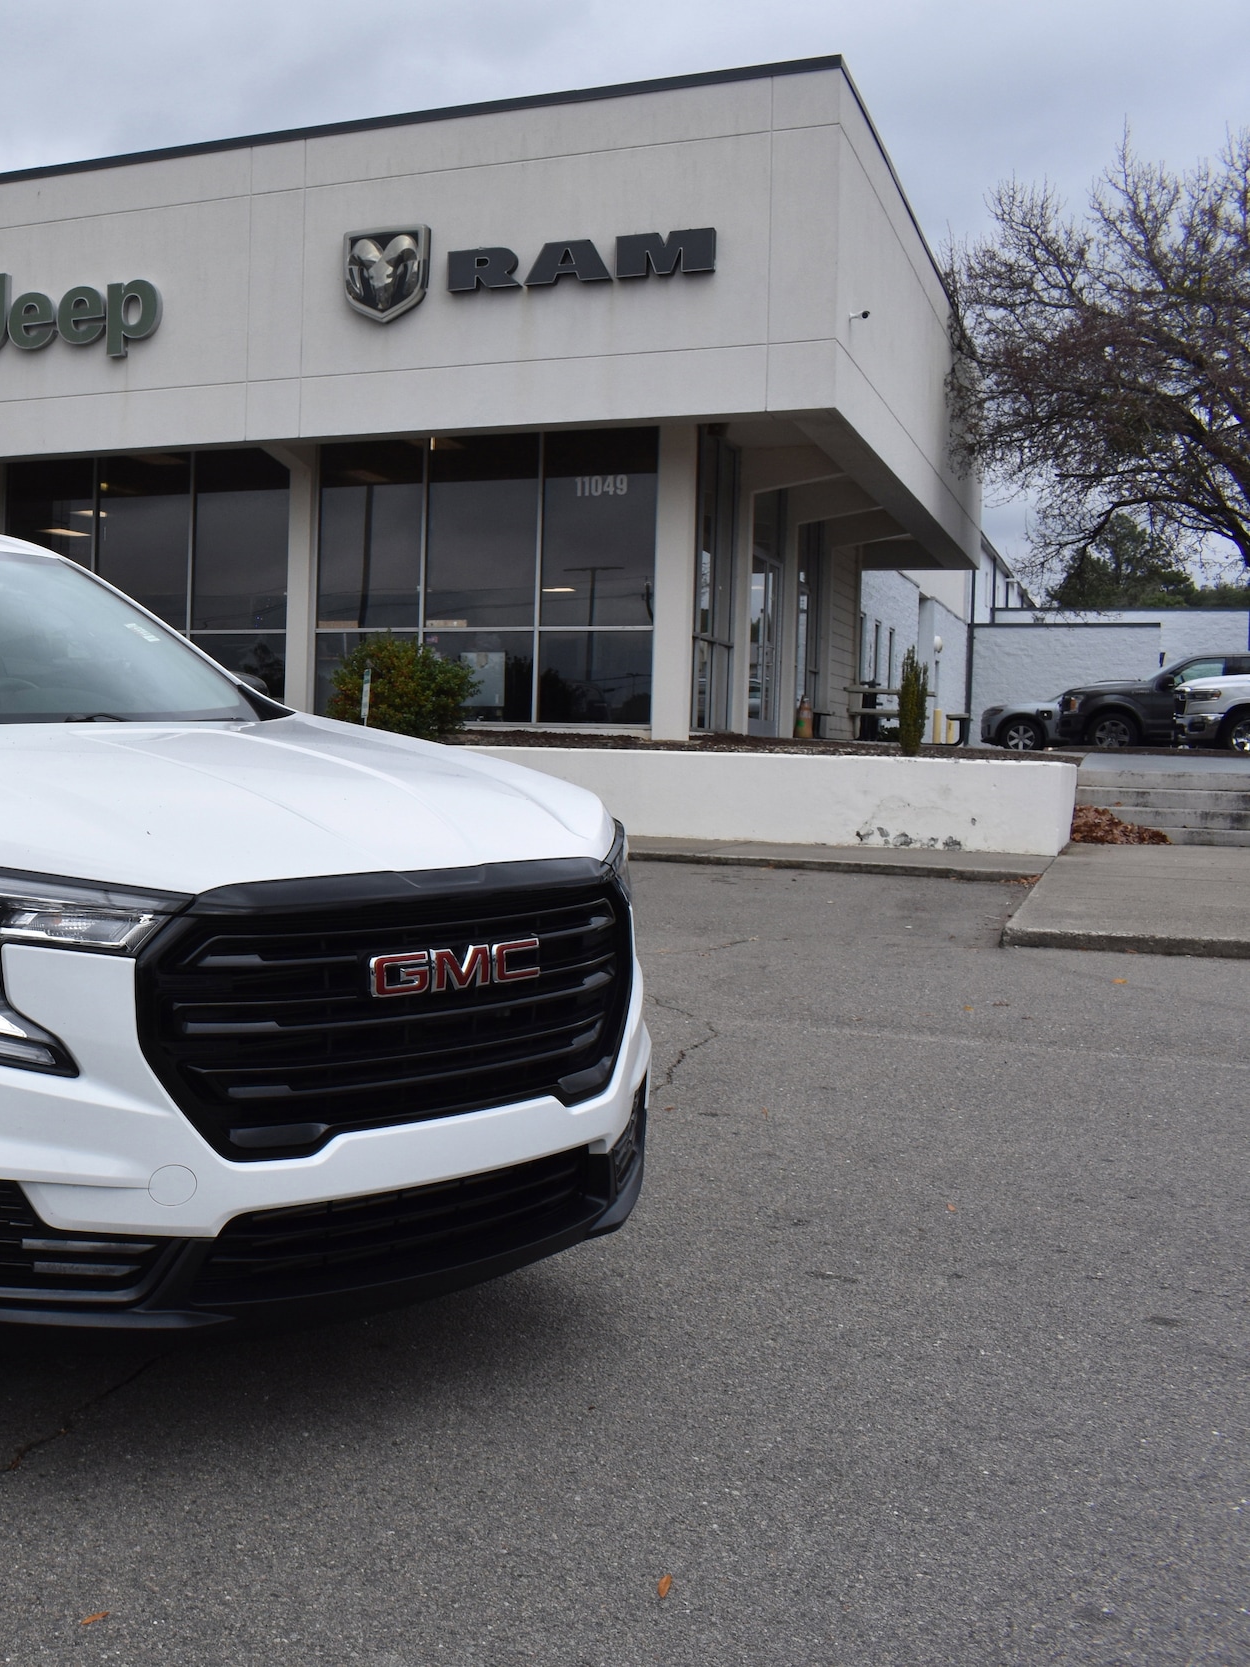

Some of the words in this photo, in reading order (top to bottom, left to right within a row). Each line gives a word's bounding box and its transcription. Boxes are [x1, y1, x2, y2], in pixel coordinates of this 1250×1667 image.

[447, 227, 717, 292] RAM
[575, 474, 628, 497] 11049
[370, 938, 541, 998] GMC
